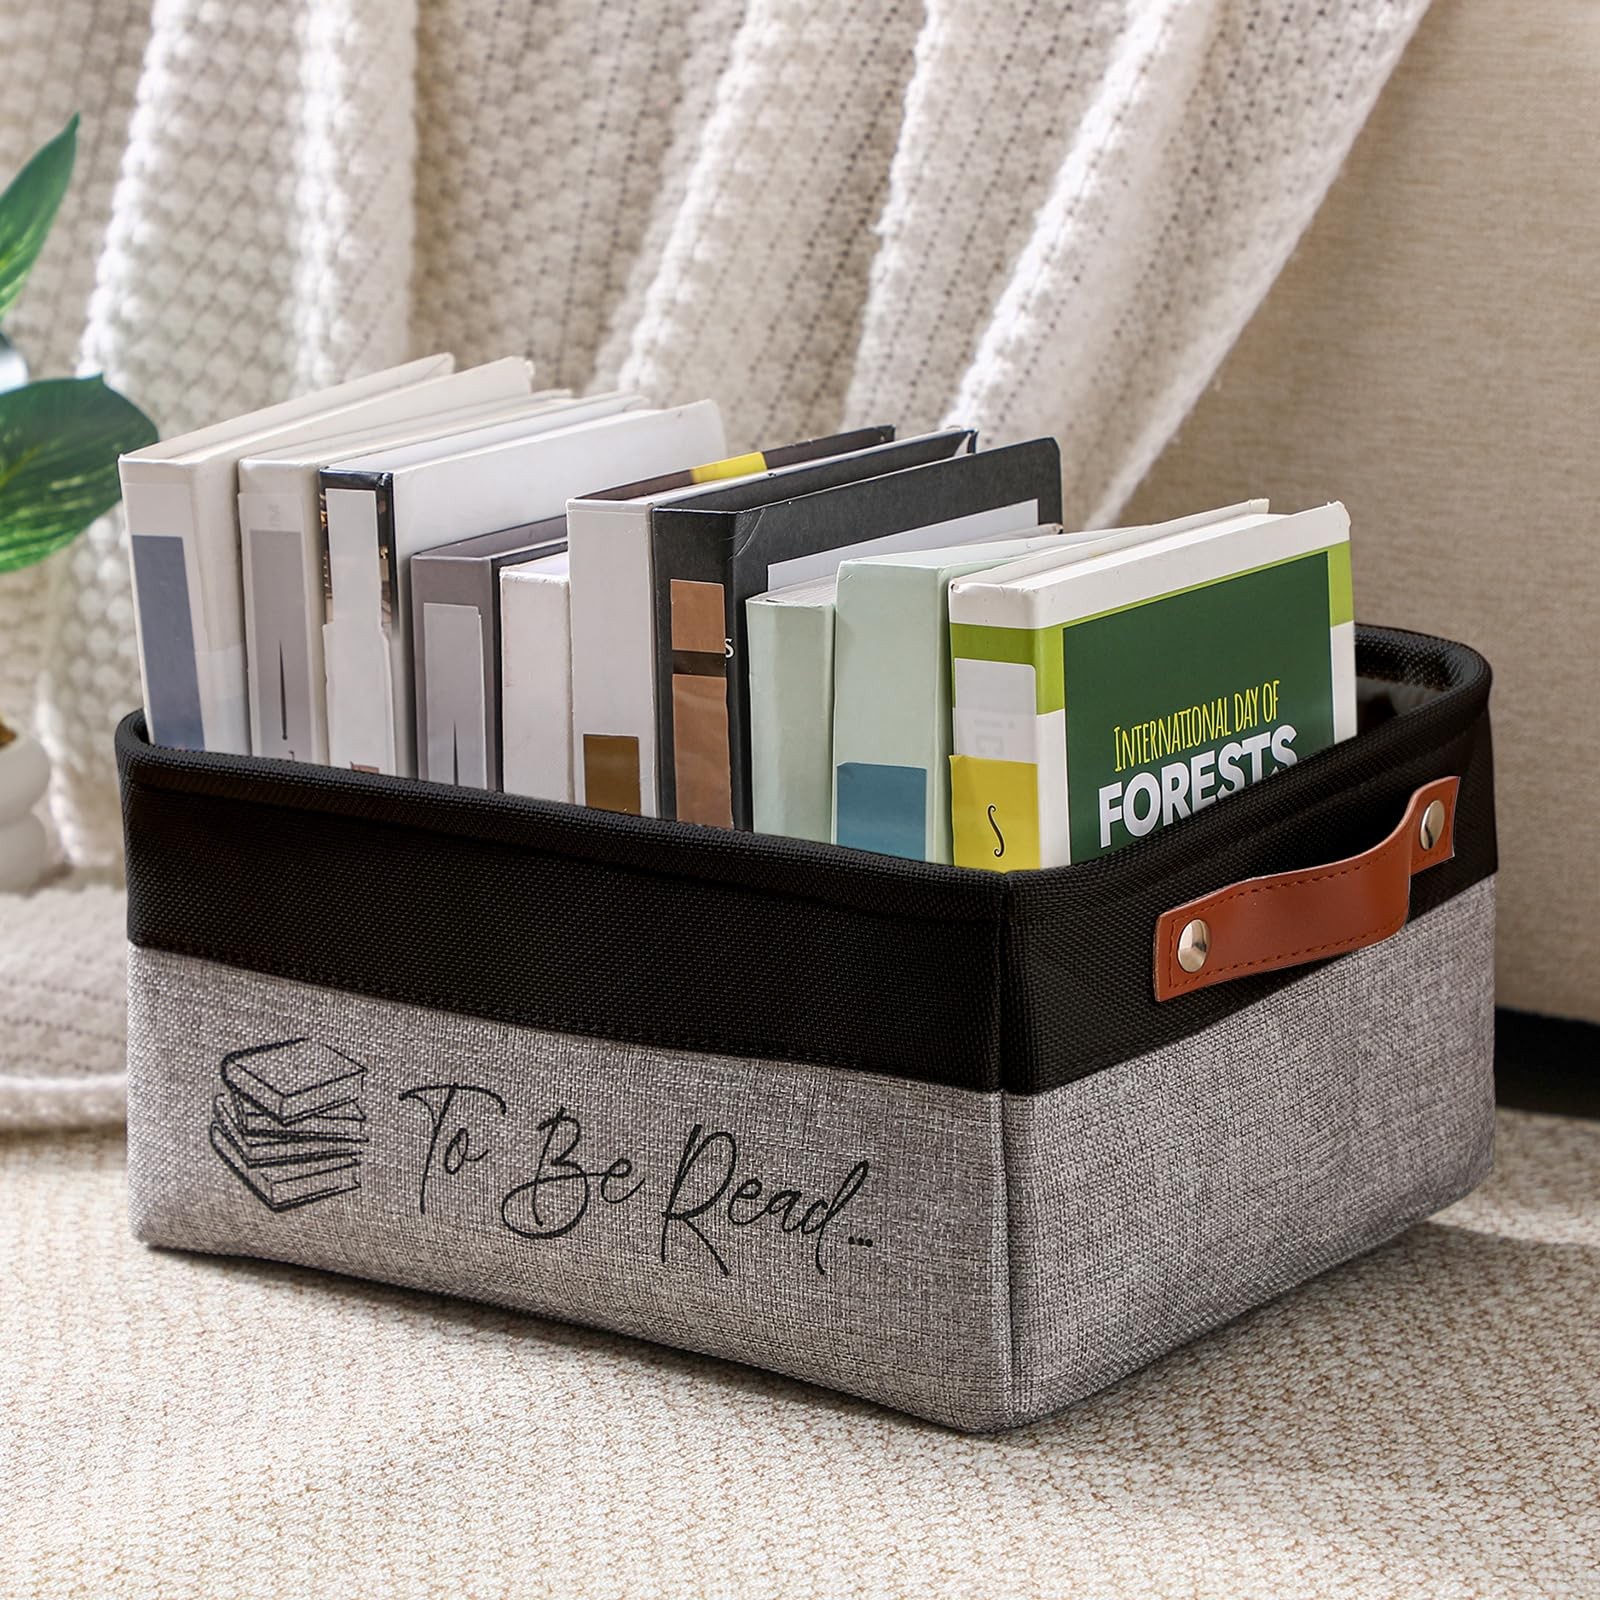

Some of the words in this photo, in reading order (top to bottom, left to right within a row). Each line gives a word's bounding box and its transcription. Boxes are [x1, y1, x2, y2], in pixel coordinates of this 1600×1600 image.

[1099, 724, 1297, 849] FORESTS
[1113, 696, 1231, 773] INTERNATIONAL
[1234, 686, 1259, 732] DAY
[1262, 680, 1280, 723] OF
[397, 1083, 506, 1214] To
[500, 1107, 647, 1240] Be
[662, 1124, 874, 1276] Read...
